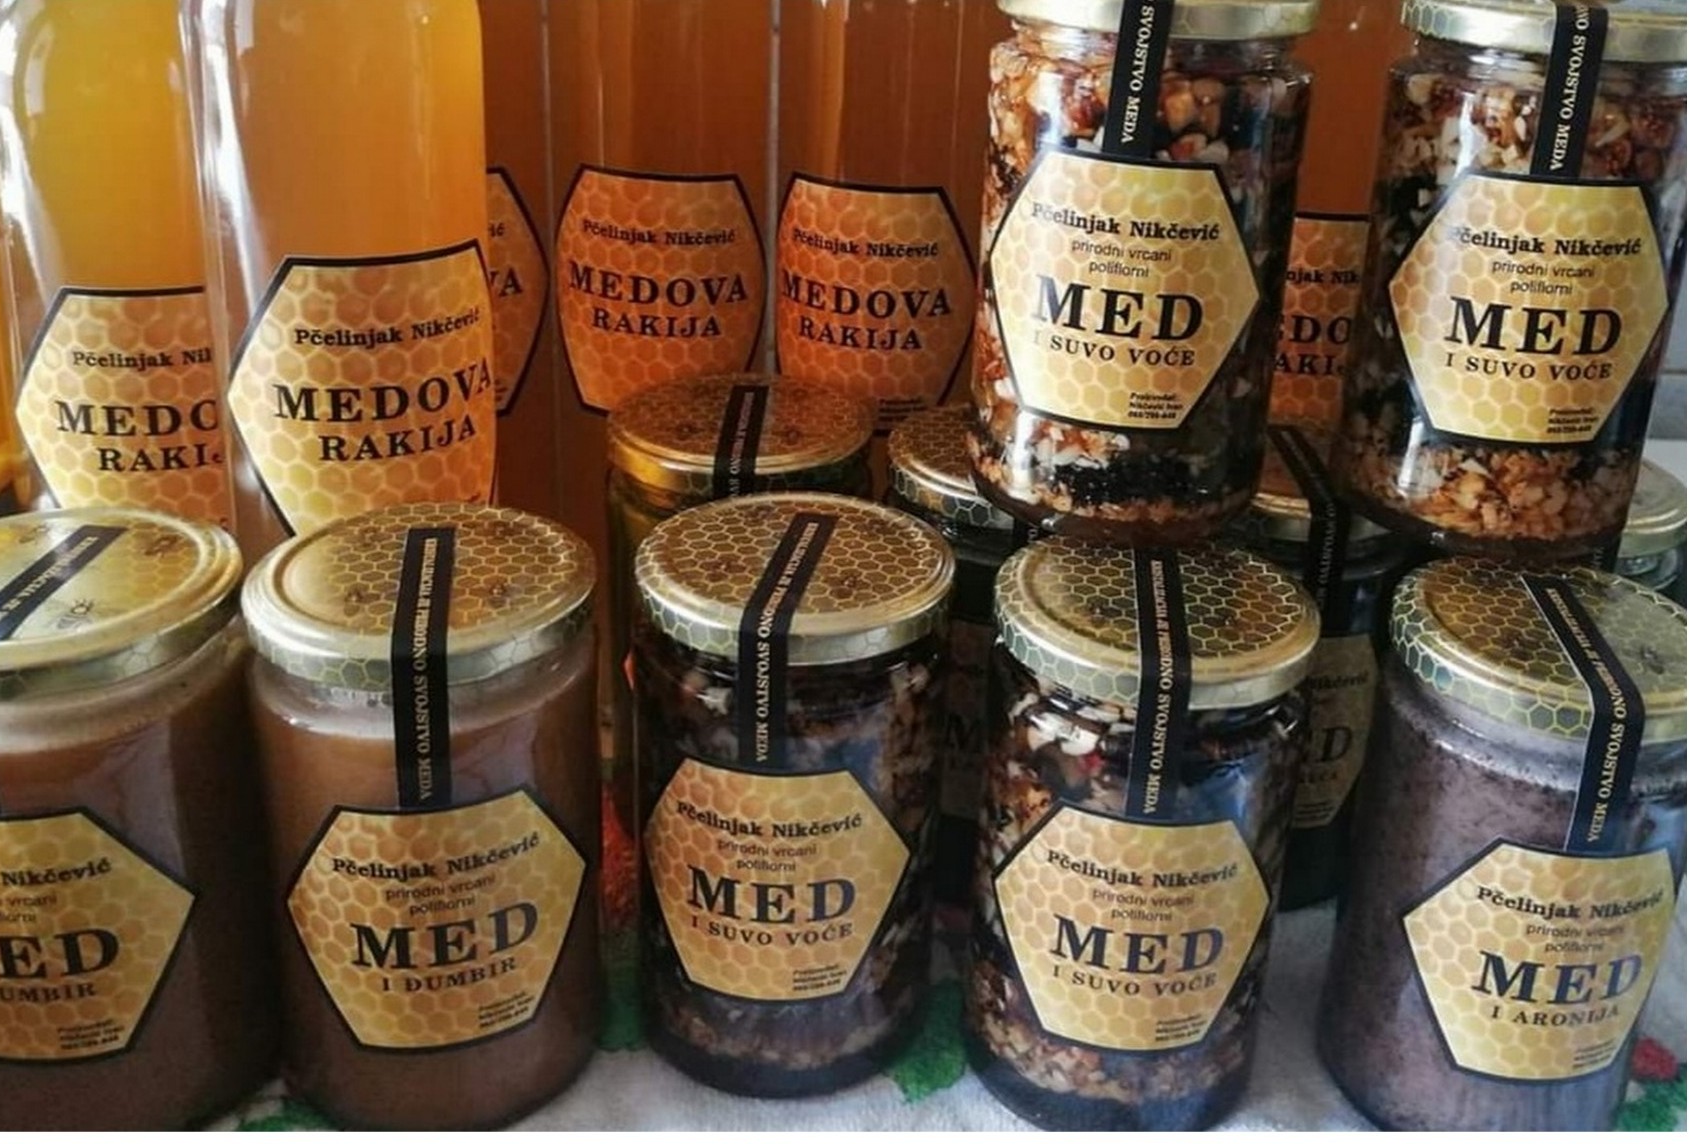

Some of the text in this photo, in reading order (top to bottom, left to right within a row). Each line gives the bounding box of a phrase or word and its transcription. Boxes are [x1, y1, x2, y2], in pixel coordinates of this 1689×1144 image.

[1120, 5, 1155, 143] SVOJSTVO MEDA
[1559, 34, 1587, 120] SVOJSTVO
[1549, 124, 1571, 171] MEDA
[583, 219, 736, 246] Pčelinjak Nikčević
[1032, 202, 1220, 241] Pčelinjak Nikčević
[793, 228, 938, 258] Pčelinjak Nikčević
[1072, 239, 1172, 262] prirodni vrcani
[1554, 238, 1642, 257] Nikčević
[569, 259, 748, 308] MEDOVA
[1089, 260, 1149, 278] poliflorni
[1492, 260, 1595, 278] prirodni vrcani
[782, 268, 951, 320] MEDOVA
[1032, 273, 1204, 341] MED
[295, 307, 481, 350] Pčelinjak Nikčević
[592, 306, 721, 338] RAKIJA
[798, 315, 922, 350] RAKIJA
[1278, 314, 1351, 345] DO
[1443, 295, 1623, 356] MED
[72, 350, 173, 372] Pčelinjak
[1049, 335, 1116, 361] SUVO
[1128, 345, 1196, 367] VOĆE
[1446, 352, 1613, 382] I SUVO VOĆE
[272, 356, 492, 423] MEDOVA
[318, 413, 477, 462] RAKIJA
[756, 641, 770, 718] SVOJSTVO
[414, 675, 430, 754] SVOJSTVO
[1149, 694, 1171, 770] SVOJSTVO
[755, 722, 769, 762] MEDA
[1597, 722, 1625, 799] SVOJSTVO
[417, 757, 433, 800] MEDA
[1143, 773, 1161, 814] MEDA
[676, 800, 862, 839] Pčelinjak Nikčević
[1587, 802, 1608, 842] MEDA
[0, 856, 111, 887] Nikčević
[332, 832, 540, 883] Pčelinjak Nikčević
[1047, 850, 1239, 888] Pčelinjak Nikčević
[687, 864, 856, 925] MED
[1477, 885, 1580, 920] Pčelinjak
[350, 901, 539, 970] MED
[691, 915, 854, 947] I SUVO VOĆE
[1049, 913, 1224, 976] MED
[382, 977, 391, 992] I
[1052, 964, 1217, 996] I SUVO VOĆE
[1471, 950, 1642, 1005] MED
[1491, 1005, 1620, 1027] I ARONIJA
